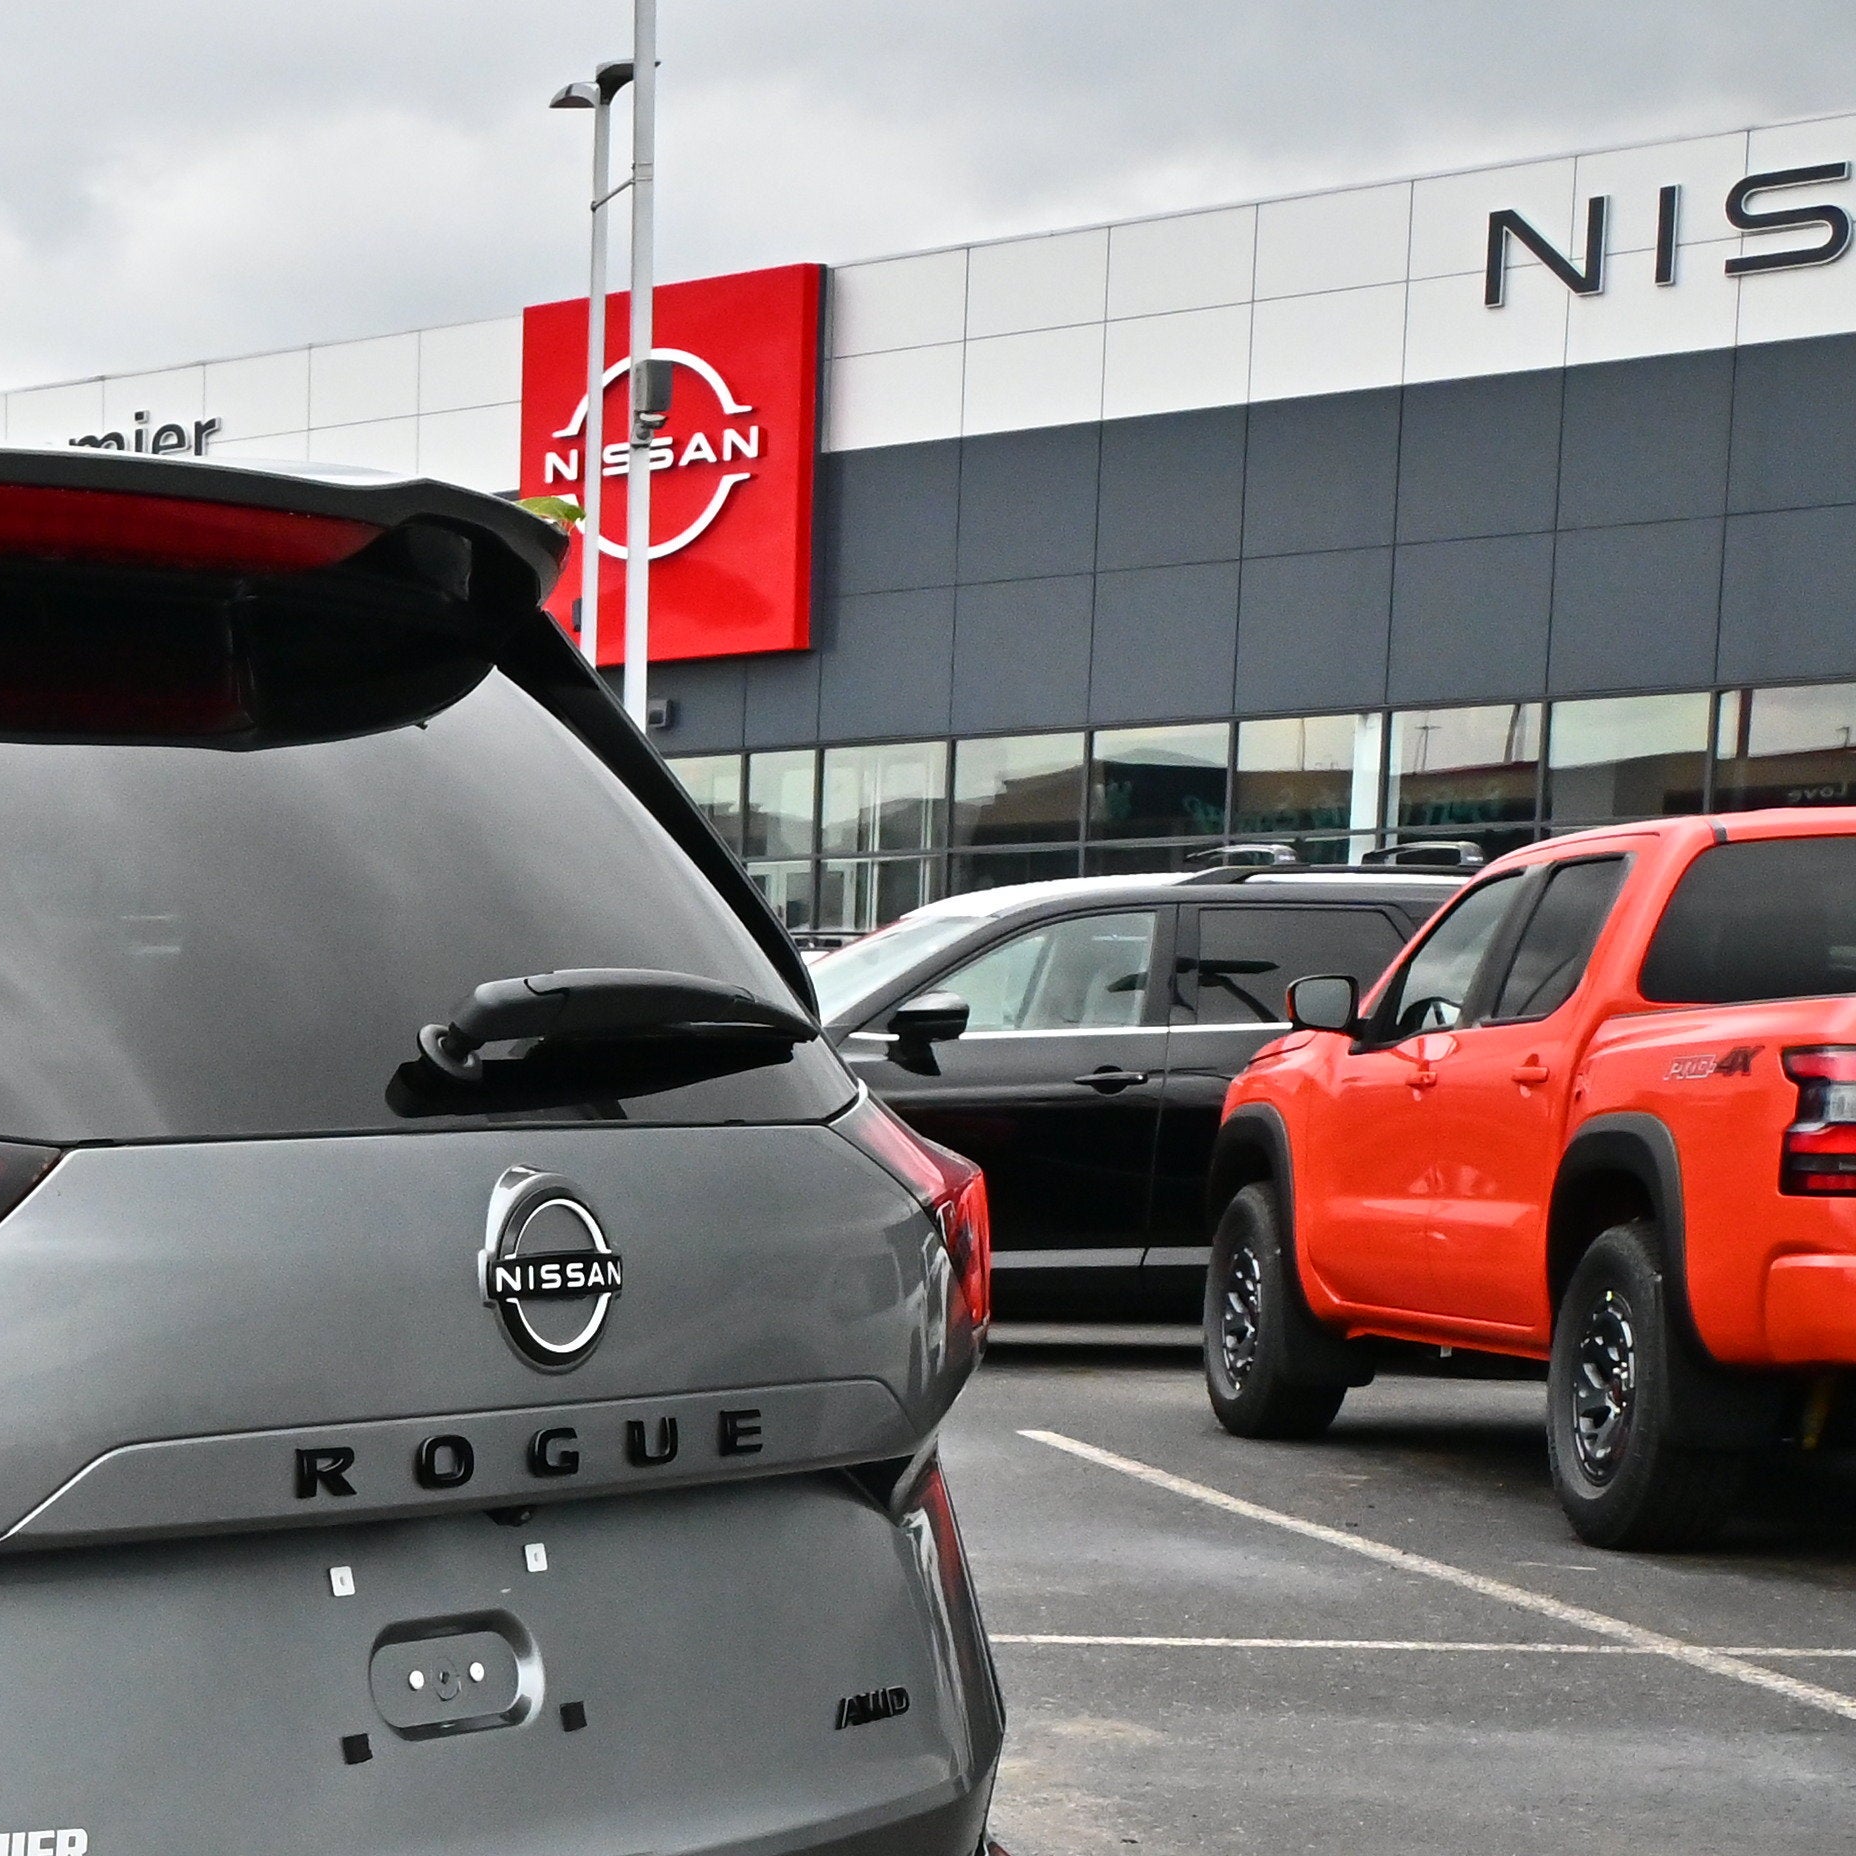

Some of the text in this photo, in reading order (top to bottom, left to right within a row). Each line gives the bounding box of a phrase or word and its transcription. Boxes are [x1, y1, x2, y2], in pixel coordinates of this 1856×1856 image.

[544, 425, 760, 484] NSSAN
[495, 1260, 622, 1293] NISSAN
[294, 1408, 764, 1499] ROGUE
[834, 1686, 910, 1730] AWD
